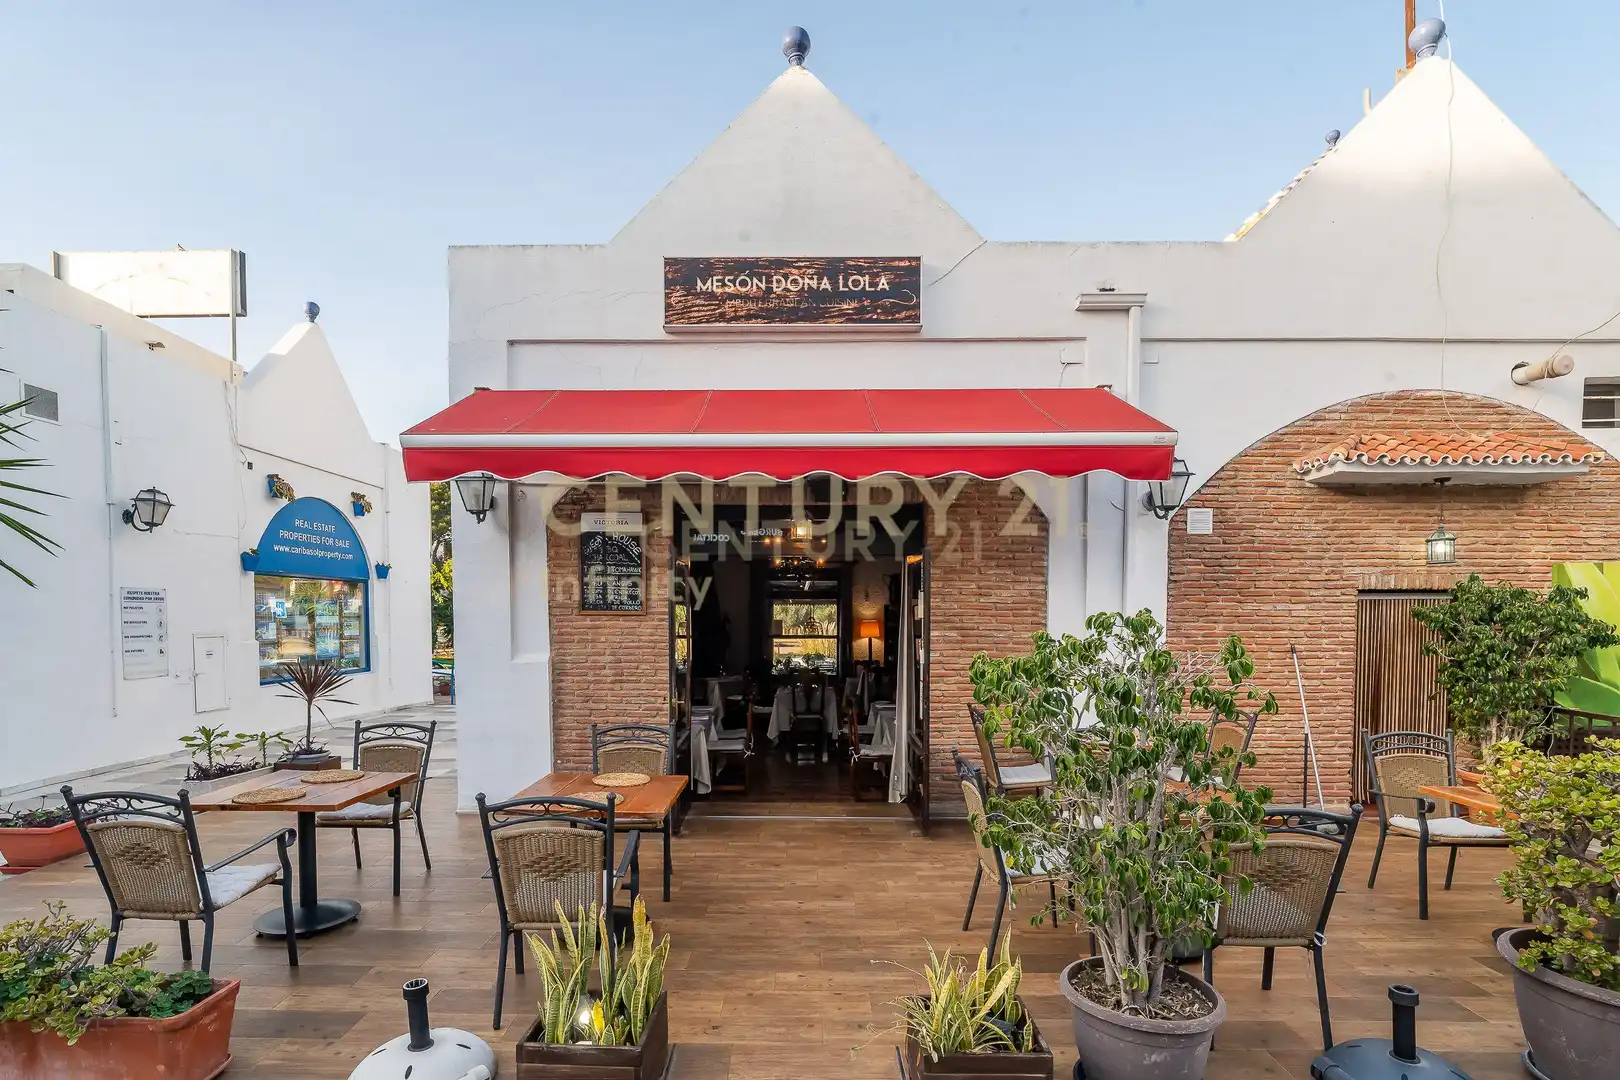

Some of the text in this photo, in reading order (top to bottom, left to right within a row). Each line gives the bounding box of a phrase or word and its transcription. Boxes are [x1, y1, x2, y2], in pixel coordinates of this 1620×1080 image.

[696, 269, 890, 292] MESÓN DOÑA LOLA
[294, 519, 336, 534] REAL ESTATE
[279, 529, 350, 549] PROPERTIES FOR SALE
[612, 532, 642, 555] HOUSE
[273, 544, 354, 561] www.caribasolproperty.com
